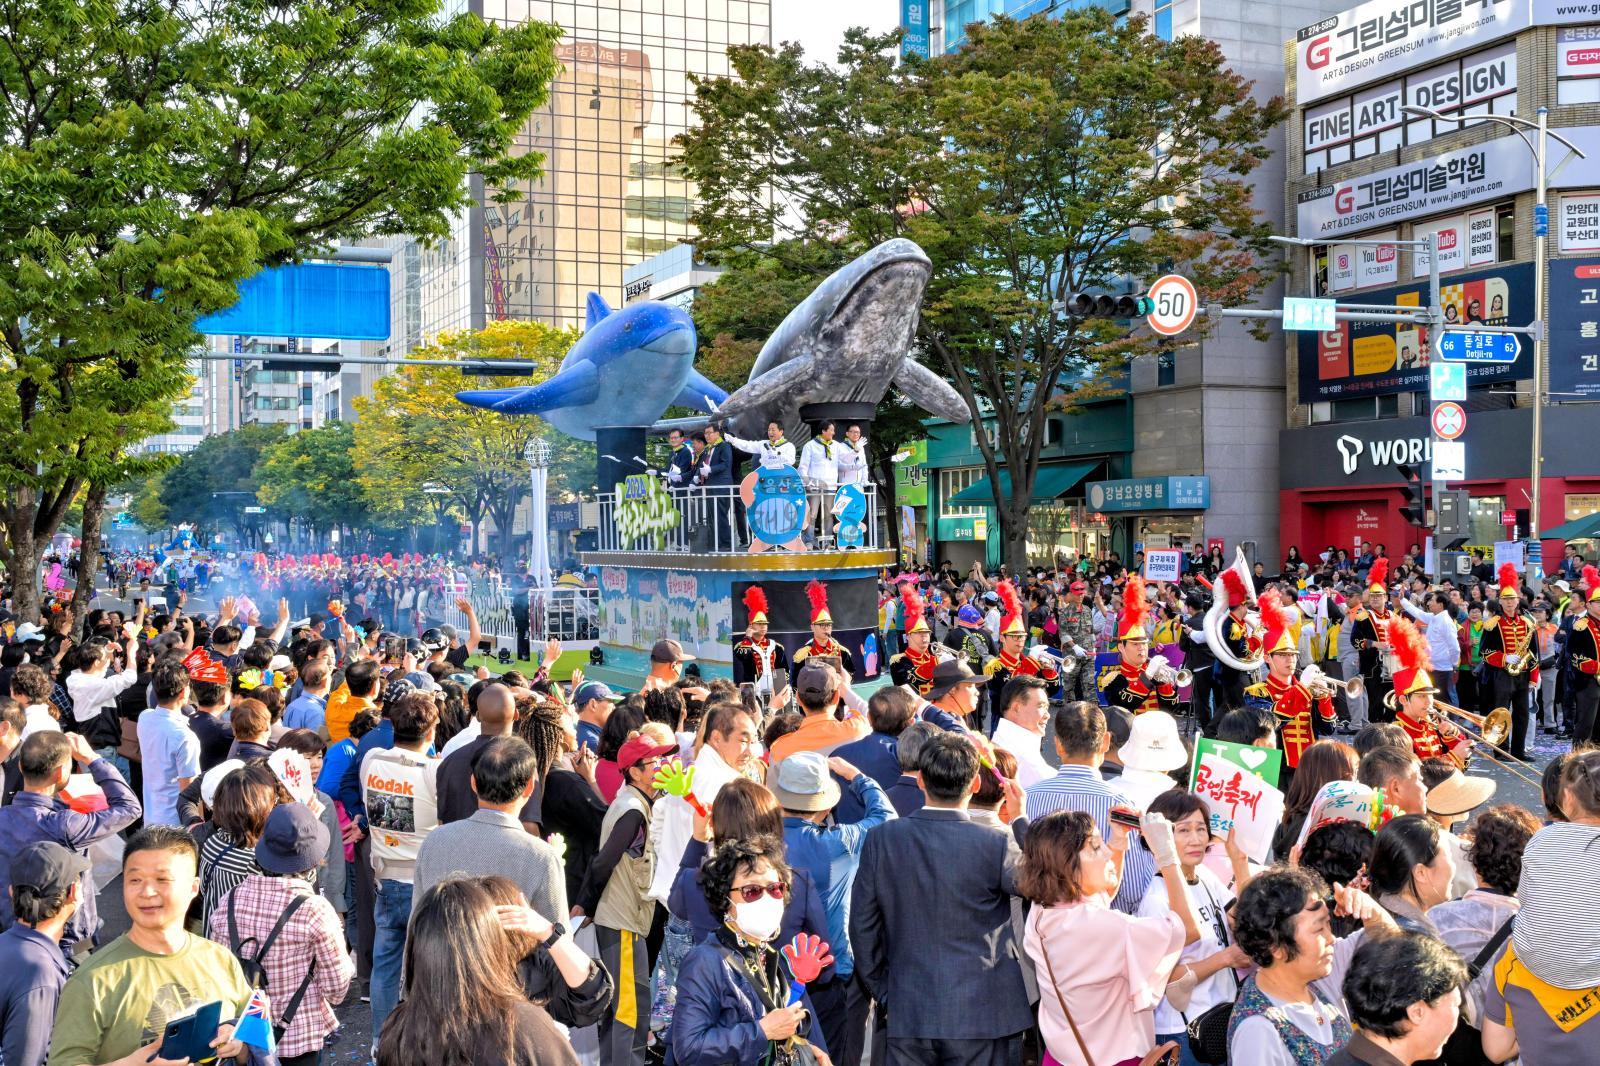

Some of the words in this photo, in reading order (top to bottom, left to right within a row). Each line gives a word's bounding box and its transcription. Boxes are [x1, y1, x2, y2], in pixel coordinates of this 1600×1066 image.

[1556, 3, 1600, 15] www.g
[1335, 0, 1503, 62] 그린섬미술
[1377, 38, 1424, 62] GREENSUM
[1427, 14, 1496, 45] www.jangjiwon.com
[1308, 111, 1349, 145] FINE
[1358, 95, 1399, 130] ART
[1415, 60, 1507, 111] DESIGN
[1356, 151, 1486, 212] 그린섬미술학원
[1378, 198, 1428, 218] GREENSUM
[1430, 180, 1503, 206] www.jangjiwon.com
[1566, 203, 1599, 215] 한양대
[1471, 218, 1492, 231] 숙명여대
[1566, 216, 1599, 228] 교원대
[1471, 230, 1492, 244] 성신여대
[1566, 229, 1599, 241] 부산대
[1158, 292, 1185, 318] 50
[1579, 288, 1599, 305] 고
[1443, 340, 1454, 351] 66
[1463, 334, 1494, 349] 돋질로
[1504, 342, 1515, 353] 62
[1465, 349, 1493, 360] Dotjil-ro
[1580, 354, 1599, 372] 건
[1369, 436, 1432, 467] WORL
[1105, 483, 1164, 501] 강남요양병원
[367, 773, 415, 796] Kodak
[1195, 763, 1263, 822] 공업축제
